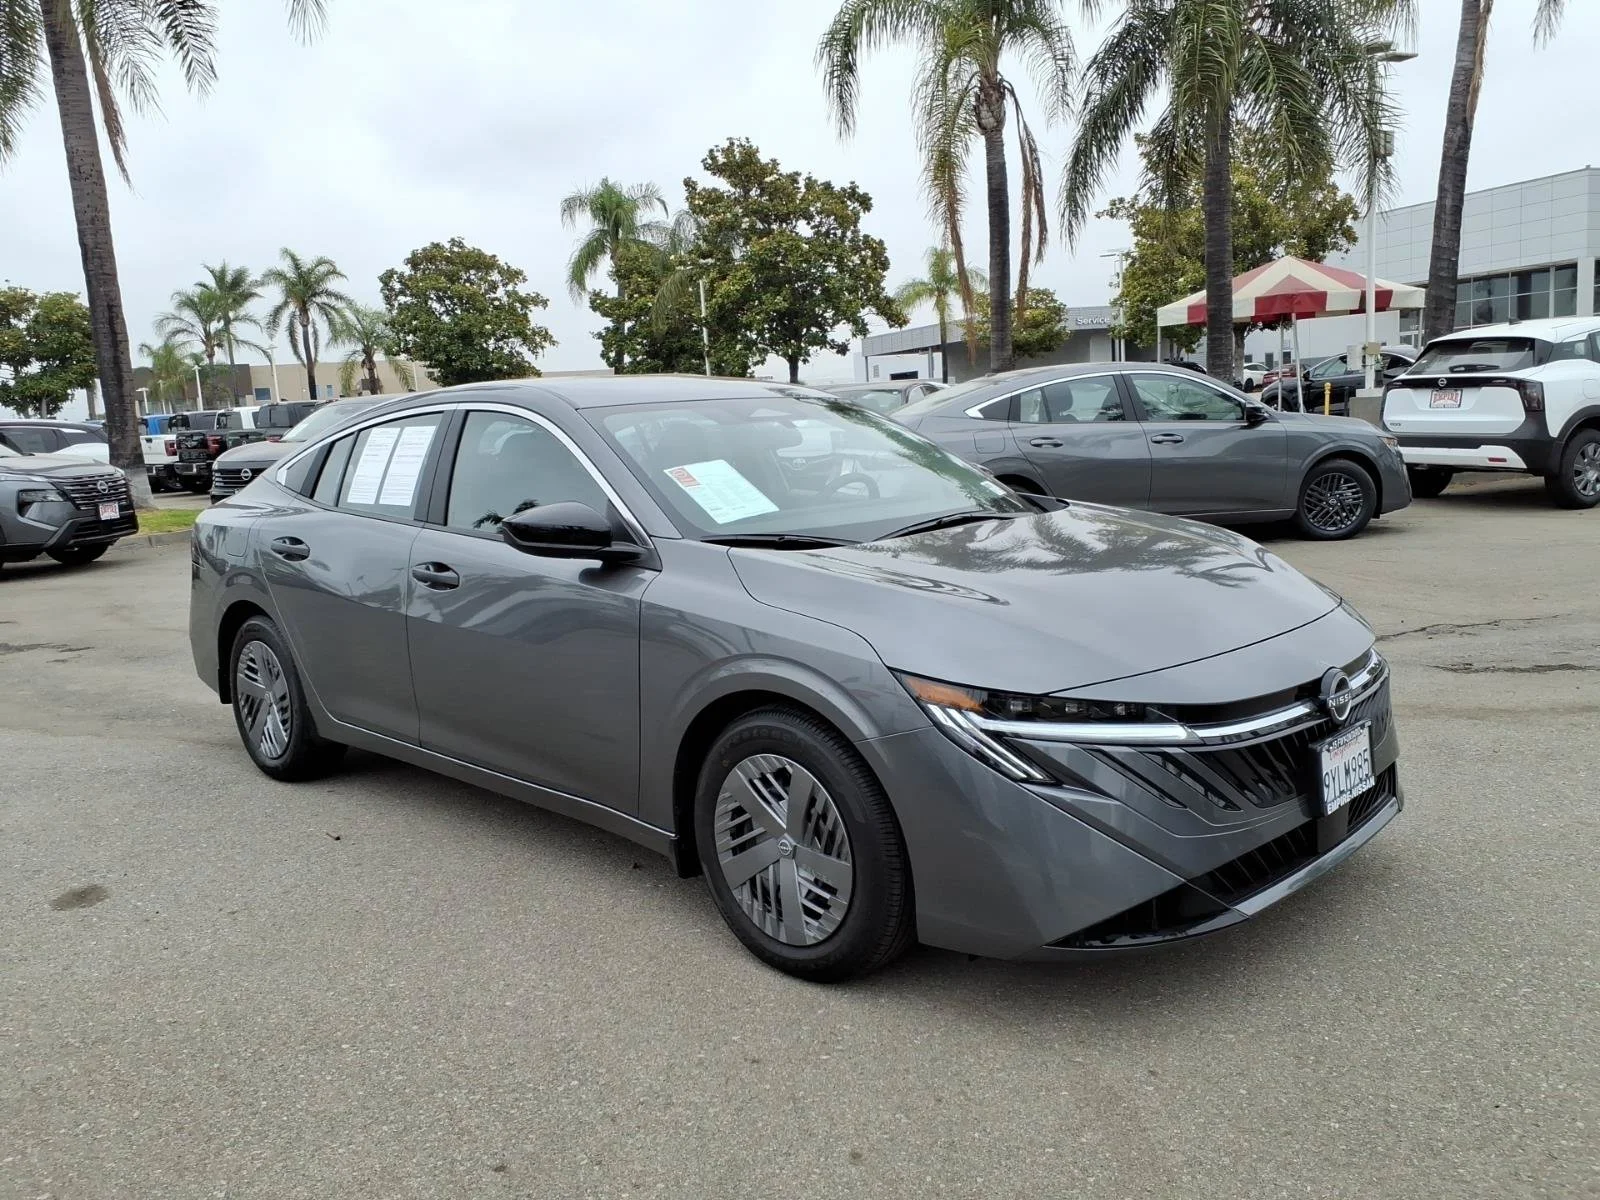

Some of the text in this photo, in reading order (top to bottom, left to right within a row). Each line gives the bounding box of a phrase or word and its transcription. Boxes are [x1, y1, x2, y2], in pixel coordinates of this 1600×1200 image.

[1076, 316, 1110, 325] Service
[1323, 748, 1370, 803] 9YLM985
[1327, 776, 1376, 815] EMPIRE NISSAN
